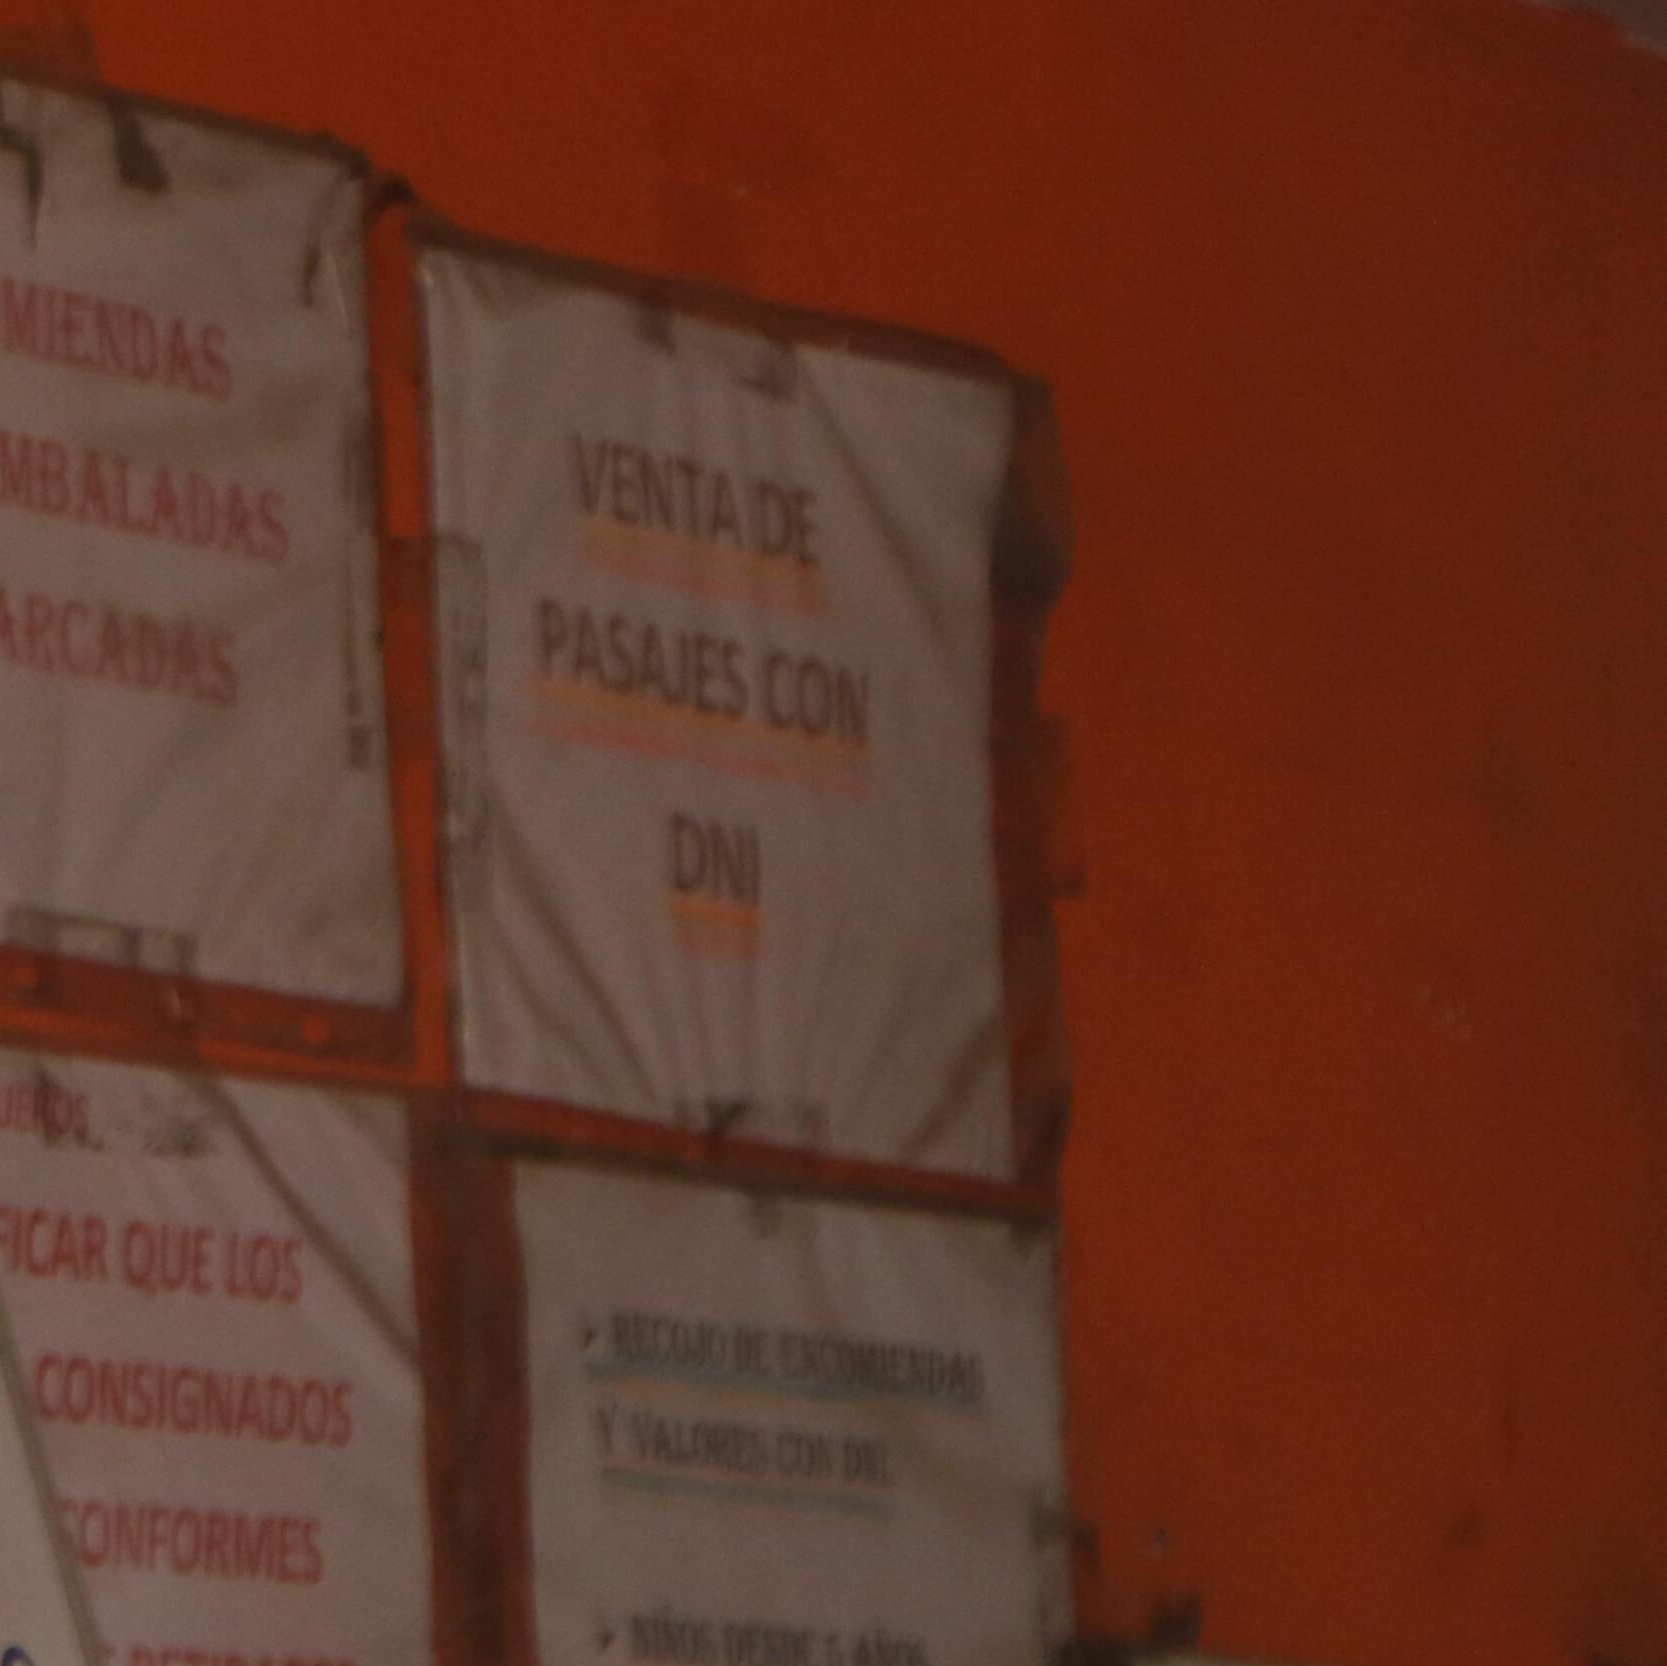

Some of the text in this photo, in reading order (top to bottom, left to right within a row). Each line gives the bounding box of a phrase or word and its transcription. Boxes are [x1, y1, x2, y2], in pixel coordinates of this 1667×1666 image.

[570, 430, 823, 568] VENTA DE
[532, 594, 870, 748] PASAJES CON
[667, 809, 763, 901] DNI
[121, 1218, 216, 1296] QUE
[225, 1230, 304, 1303] LOS
[30, 1351, 355, 1450] CONSIGNADOS
